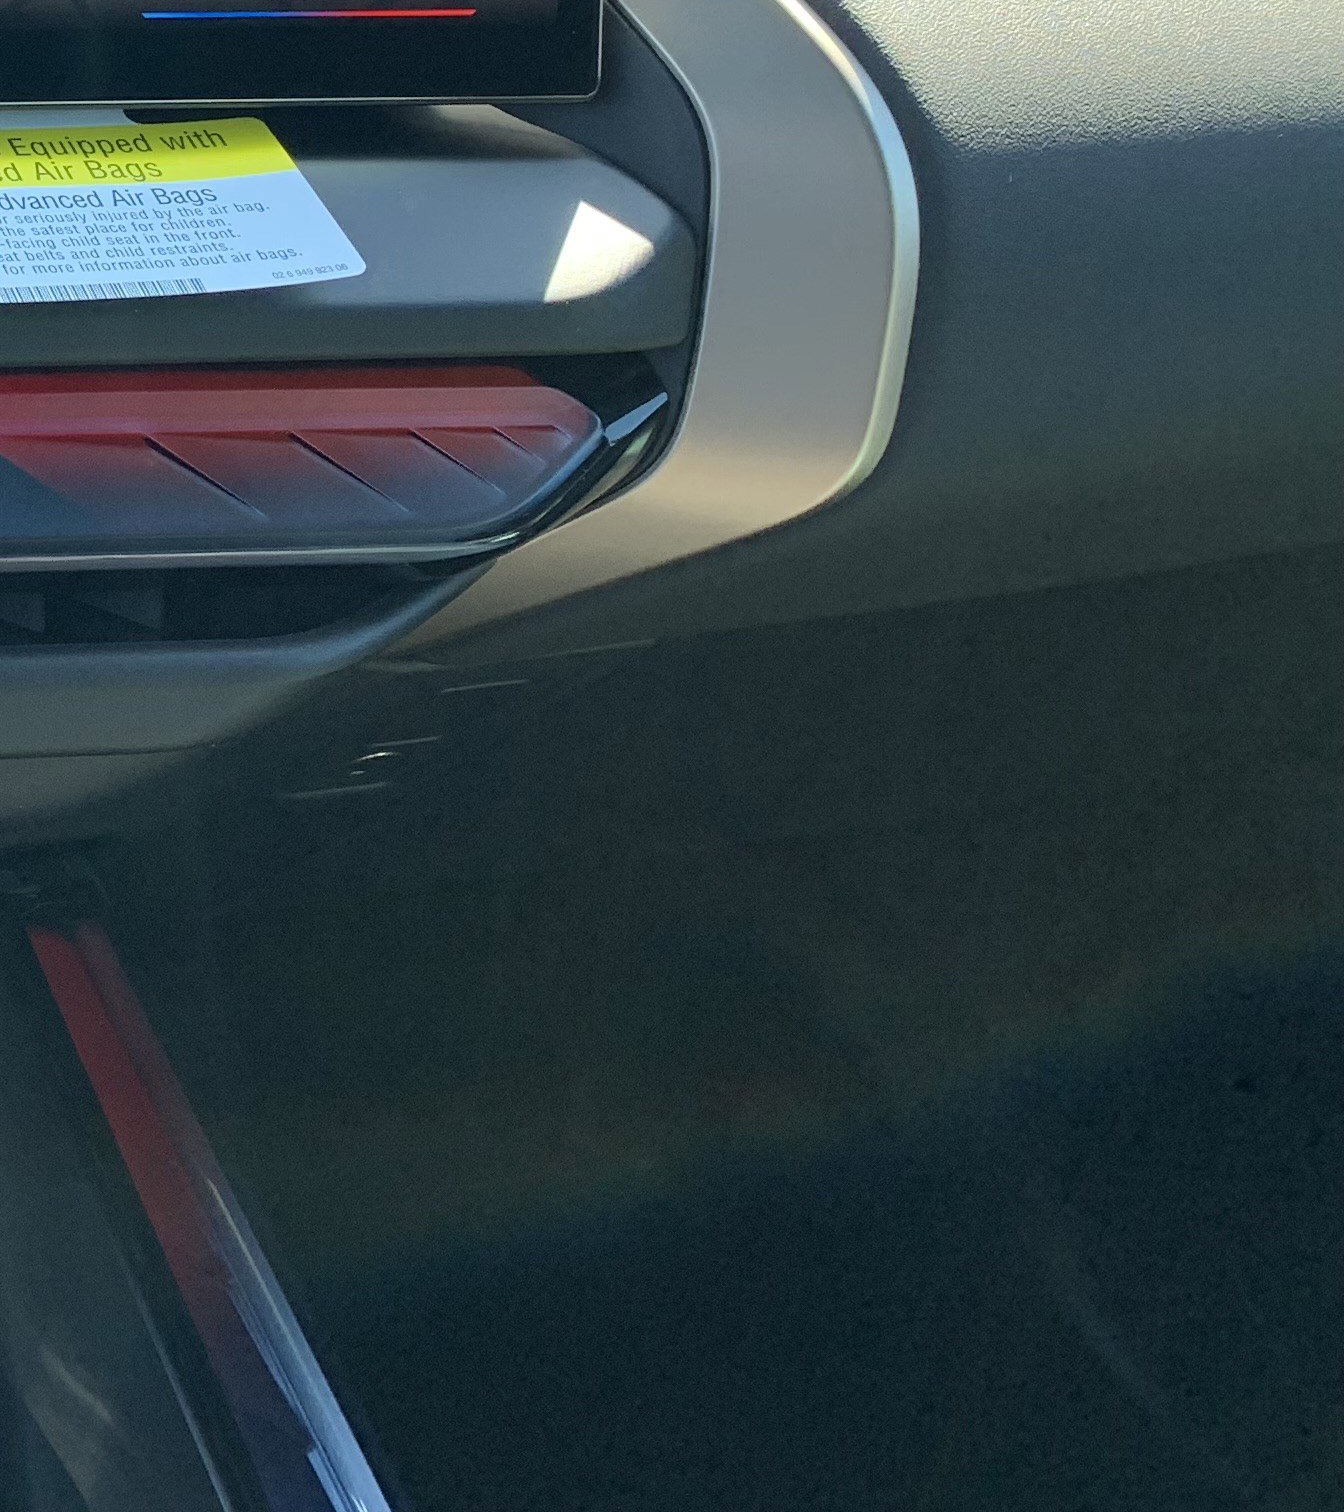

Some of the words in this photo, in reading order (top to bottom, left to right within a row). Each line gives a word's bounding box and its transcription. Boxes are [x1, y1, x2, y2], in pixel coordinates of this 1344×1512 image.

[8, 133, 153, 159] Equipped
[160, 129, 228, 150] with
[34, 160, 74, 182] Air
[83, 159, 163, 184] Bags
[111, 188, 144, 208] Air
[150, 187, 218, 206] Bags
[14, 210, 87, 225] seriously
[93, 208, 149, 223] injured
[155, 207, 172, 221] by
[177, 205, 204, 217] the
[209, 204, 229, 215] air
[233, 201, 271, 214] bag.
[0, 226, 26, 237] the
[31, 224, 81, 237] safest
[85, 222, 127, 236] place
[132, 221, 155, 232] for
[161, 217, 232, 232] children.
[61, 236, 101, 248] child
[107, 234, 140, 246] seat
[145, 233, 160, 244] in
[168, 231, 191, 243] the
[194, 228, 242, 241] front.
[2, 264, 25, 276] for
[31, 263, 74, 275] more
[78, 257, 175, 273] information
[180, 253, 227, 267] about
[231, 252, 252, 264] air
[256, 246, 303, 262] bags.
[26, 249, 65, 262] belts
[70, 248, 100, 260] and
[105, 246, 145, 259] child
[150, 241, 235, 256] restraints.
